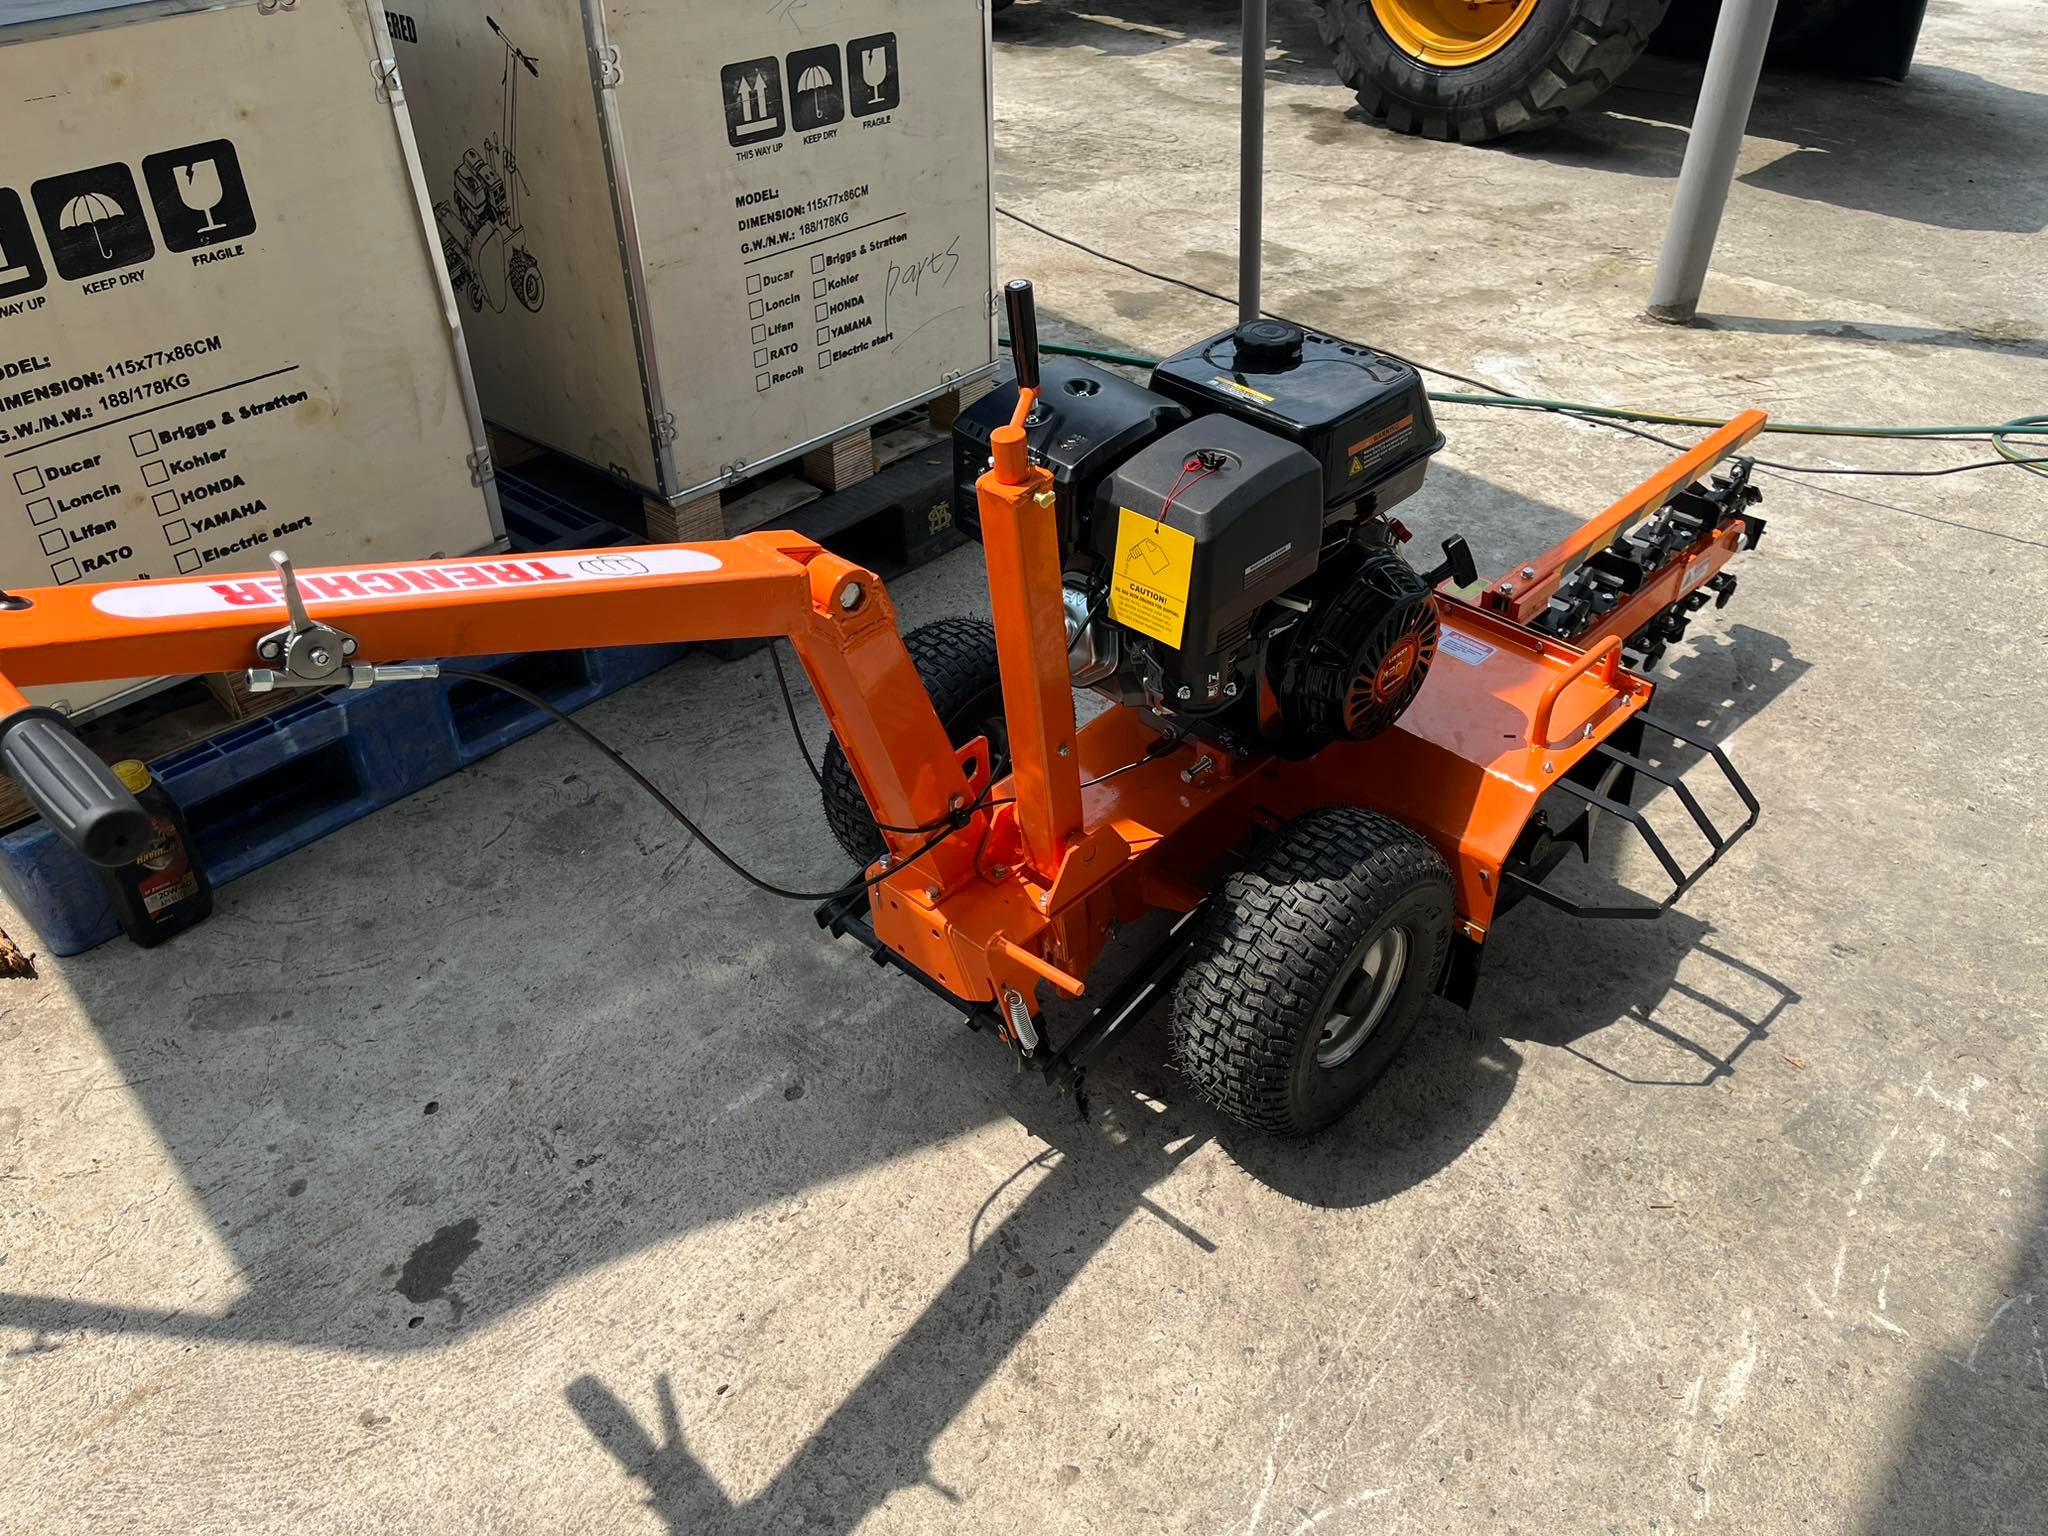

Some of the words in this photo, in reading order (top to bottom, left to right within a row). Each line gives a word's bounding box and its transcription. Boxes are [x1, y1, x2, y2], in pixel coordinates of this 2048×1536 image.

[384, 10, 417, 44] ERED
[863, 115, 891, 129] FRAGILE
[803, 132, 822, 145] KEEP
[823, 129, 837, 140] DRY
[736, 150, 754, 161] THIS
[755, 145, 772, 157] WAY
[773, 142, 783, 153] UP
[735, 188, 779, 208] MODEL:
[738, 204, 805, 231] DIMENSION:
[807, 185, 869, 213] 115x77x86CM
[741, 230, 795, 254] G.W./N.W.:
[799, 212, 849, 236] 188/178KG
[191, 245, 245, 266] FRAGILE
[825, 250, 857, 268] Briggs
[860, 244, 867, 255] &
[870, 232, 907, 252] Stratton
[82, 277, 117, 295] KEEP
[119, 270, 146, 287] DRY
[763, 269, 794, 287] Ducar
[828, 273, 859, 291] Kohler
[27, 297, 46, 310] UP
[765, 293, 800, 312] Loncin
[829, 295, 865, 316] HONDA
[768, 321, 794, 337] Lifan
[831, 316, 872, 339] YAMAHA
[770, 343, 798, 361] RATO
[832, 341, 868, 362] Electric
[871, 331, 893, 348] start
[0, 356, 51, 381] DEL:
[0, 372, 104, 412] IMENSION:
[106, 336, 222, 379] 115x77x86CM
[772, 366, 804, 384] Recoil
[0, 407, 93, 443] G.W./N.W.:
[99, 373, 190, 411] 188/178KG
[158, 418, 216, 445] Briggs
[221, 411, 235, 425] &
[239, 390, 308, 419] Stratton
[45, 455, 101, 481] Ducar
[170, 448, 228, 475] Kohler
[57, 482, 122, 513] Loncin
[180, 474, 246, 505] HONDA
[190, 499, 267, 534] YAMAHA
[69, 519, 117, 542] Lifan
[202, 532, 269, 563] Electric
[273, 516, 313, 539] start
[82, 545, 133, 573] RATO
[209, 561, 572, 606] TRENCHER
[1129, 583, 1168, 604] CAUTION!
